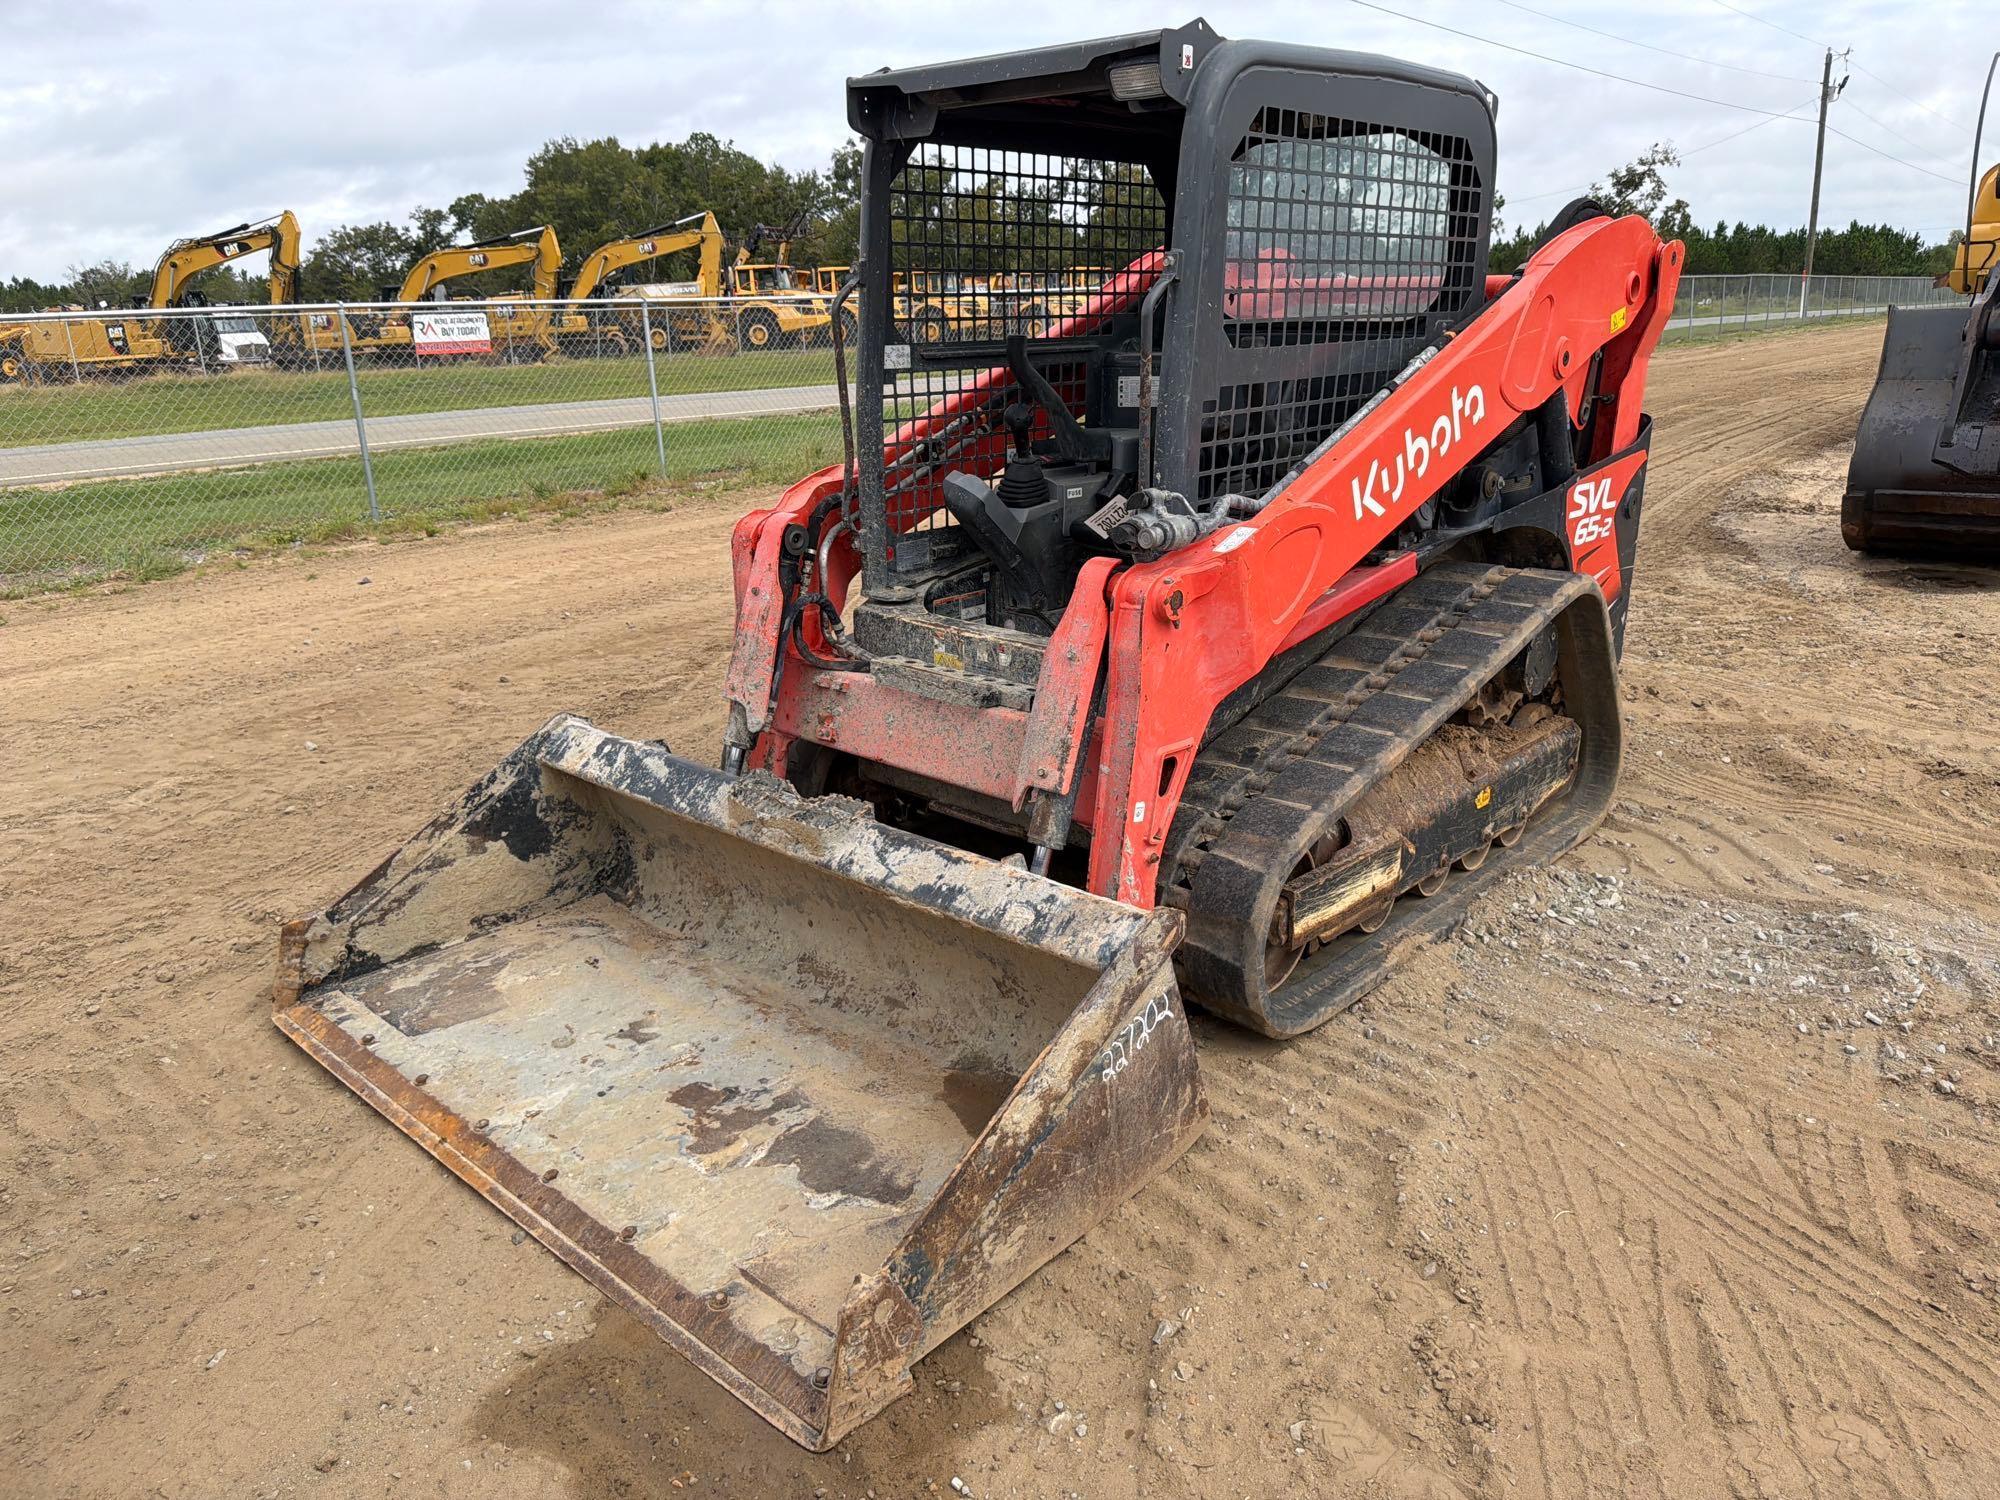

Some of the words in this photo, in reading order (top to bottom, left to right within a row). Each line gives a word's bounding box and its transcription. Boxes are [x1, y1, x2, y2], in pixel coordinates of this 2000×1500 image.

[224, 242, 240, 257] CAT
[639, 242, 653, 254] CAT
[469, 253, 485, 265] CAT
[667, 286, 697, 294] VOLVO
[496, 305, 513, 318] CAT
[311, 314, 328, 328] CAT
[108, 326, 124, 338] CAT
[441, 327, 455, 336] BUY
[1351, 384, 1485, 521] Kubota
[1568, 477, 1617, 520] SVL
[1573, 514, 1613, 546] 65-2
[1101, 991, 1175, 1081] 227202
